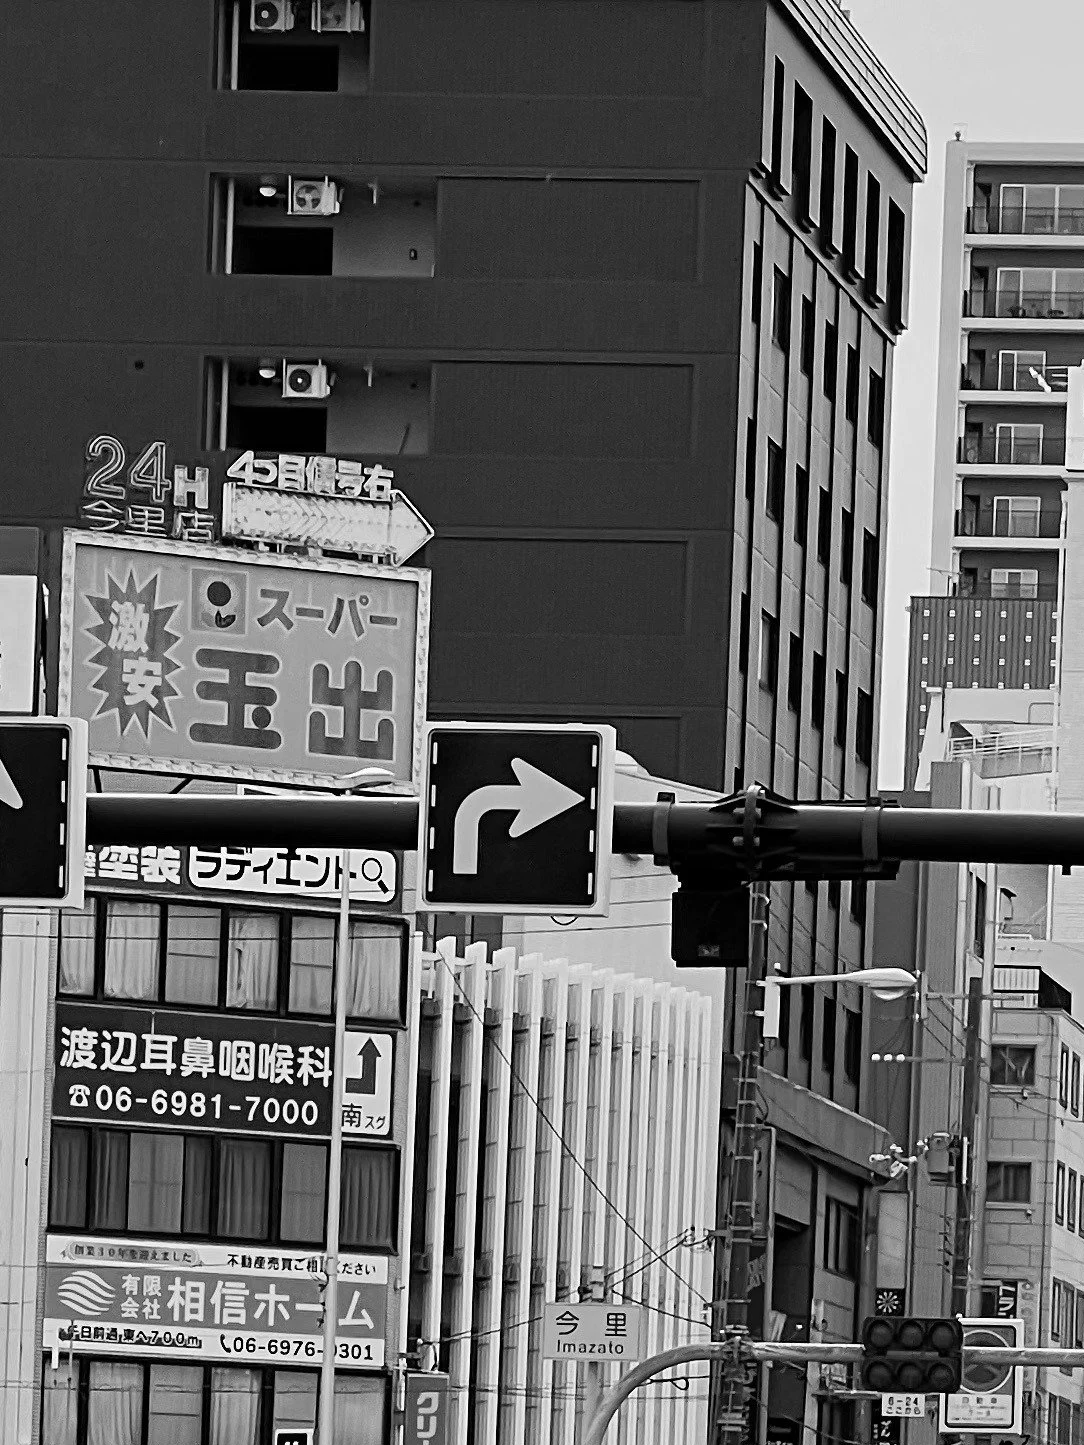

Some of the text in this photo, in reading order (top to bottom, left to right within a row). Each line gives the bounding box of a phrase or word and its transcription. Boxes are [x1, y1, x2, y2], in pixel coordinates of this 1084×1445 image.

[82, 500, 215, 541] 今里店
[256, 586, 398, 638] スーパー
[107, 600, 163, 707] 激安
[188, 647, 395, 761] 玉出
[60, 1026, 333, 1088] 渡辺耳鼻咽喉科
[95, 1084, 319, 1126] 06-6981-7000
[121, 1273, 162, 1297] 有限
[166, 1276, 375, 1330] 相信ホーム
[120, 1297, 161, 1320] 会社
[556, 1310, 628, 1337] 今里
[556, 1339, 624, 1355] Imazato
